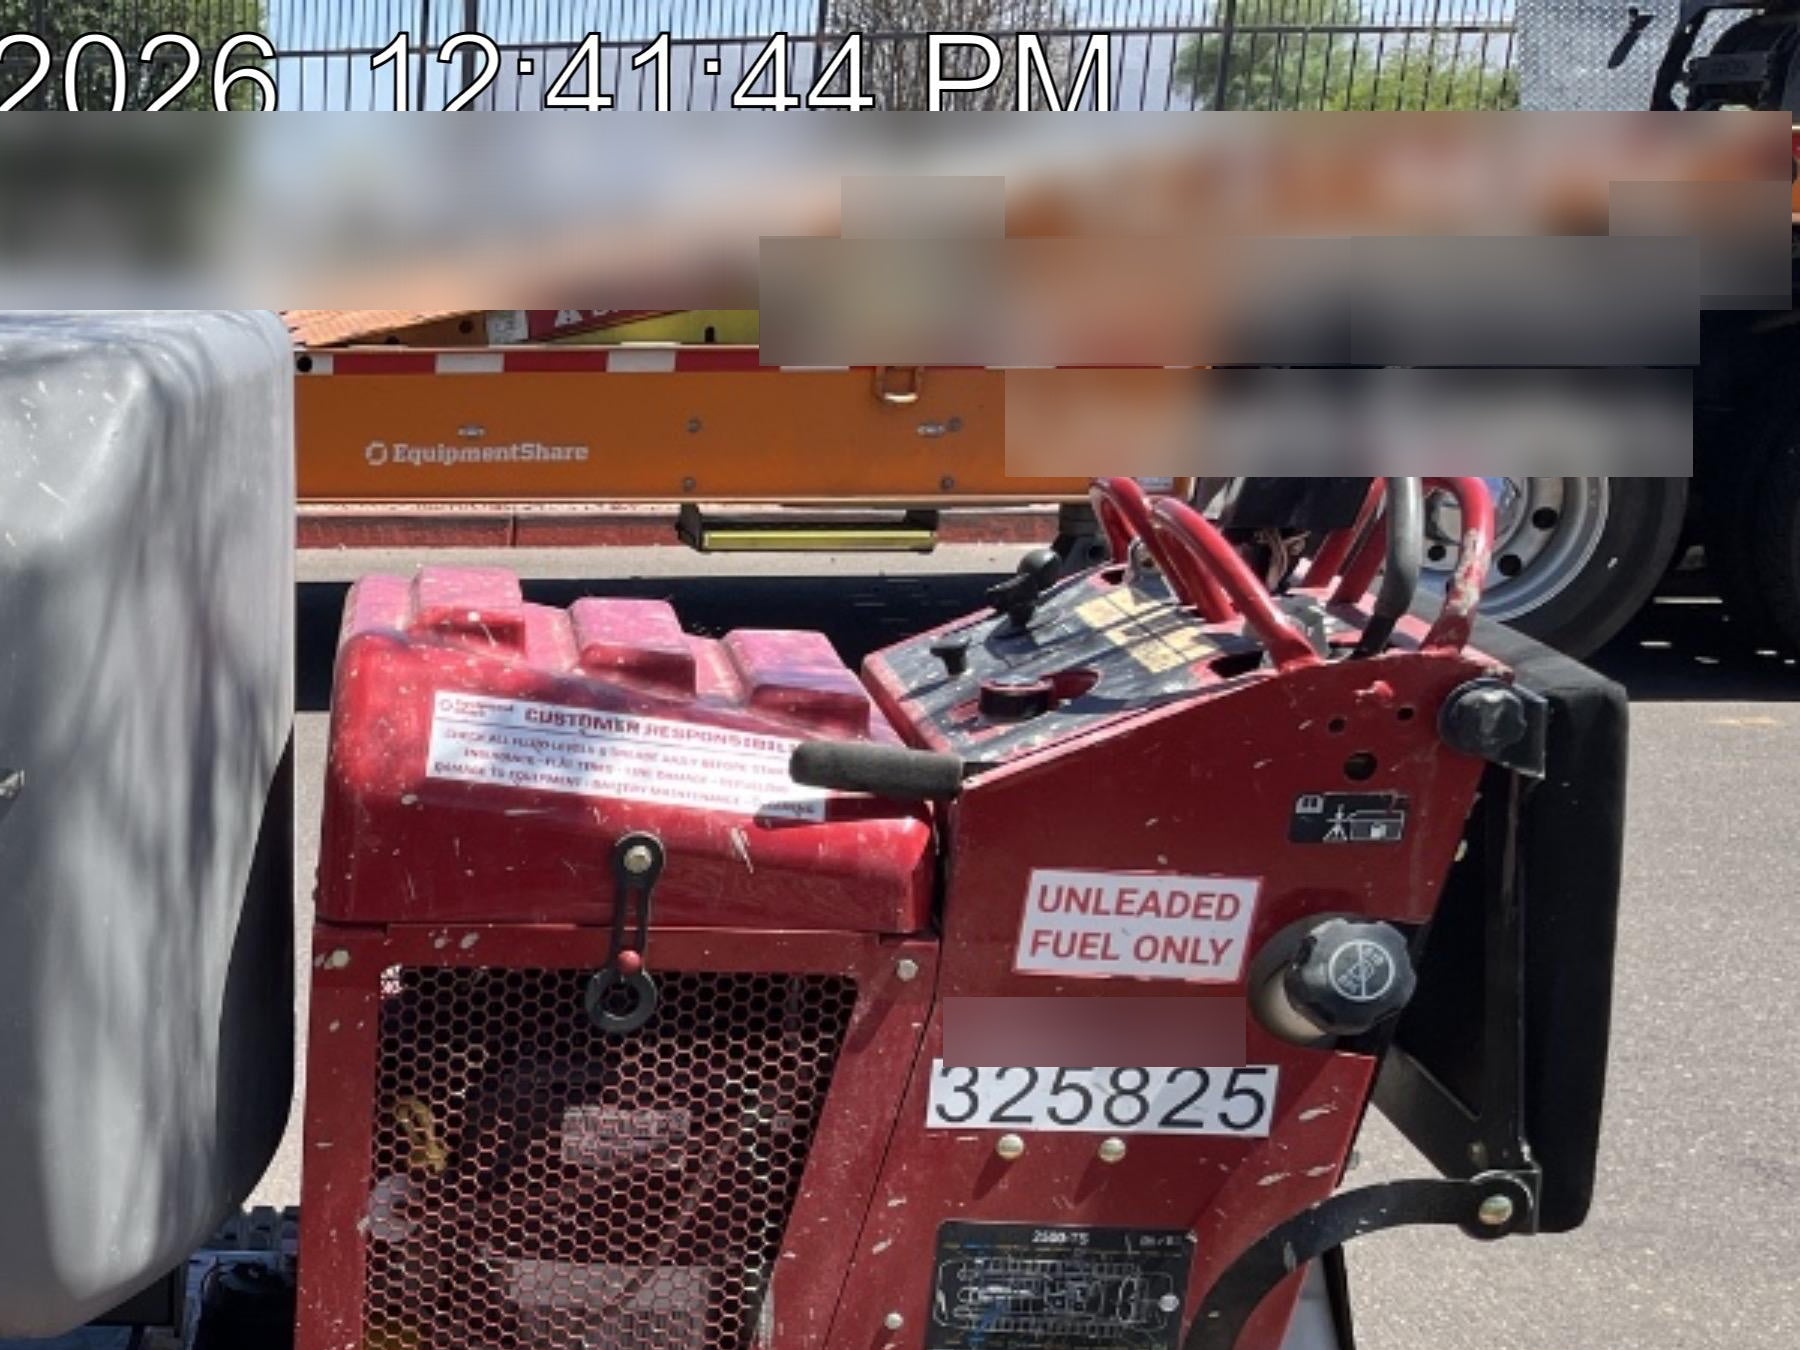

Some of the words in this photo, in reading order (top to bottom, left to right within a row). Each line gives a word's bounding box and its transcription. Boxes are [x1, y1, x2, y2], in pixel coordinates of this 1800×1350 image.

[392, 442, 589, 466] EquipmentShare
[525, 708, 640, 733] CUSTOMER
[643, 723, 797, 754] RESPONSIBIL
[1037, 884, 1241, 921] UNLEADED
[1029, 929, 1120, 961] FUEL
[1132, 933, 1234, 967] ONLY
[935, 1066, 1267, 1131] 325825
